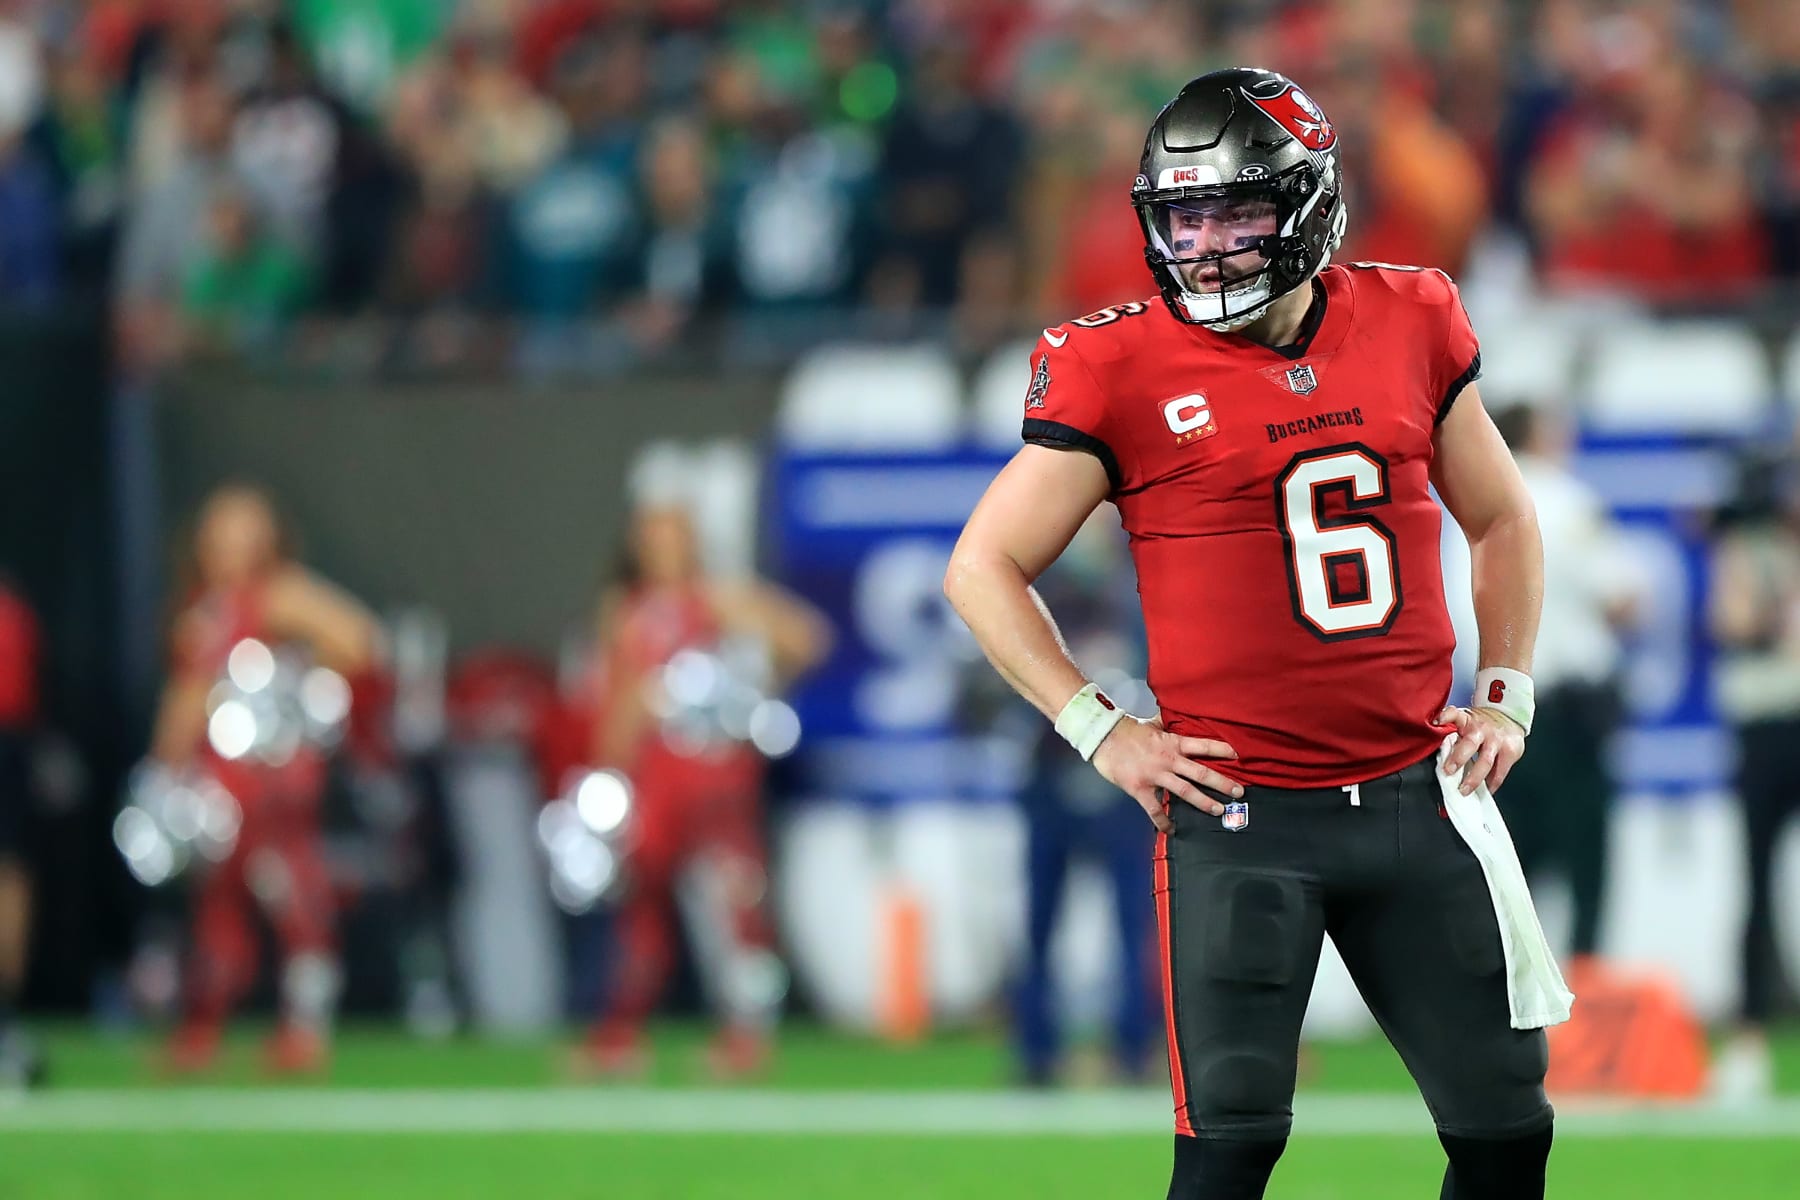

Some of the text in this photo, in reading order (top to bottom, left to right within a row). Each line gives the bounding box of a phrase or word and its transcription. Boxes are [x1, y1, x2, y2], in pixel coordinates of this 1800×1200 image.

[1163, 393, 1211, 435] C
[1274, 441, 1404, 643] 6
[1488, 679, 1506, 703] 6
